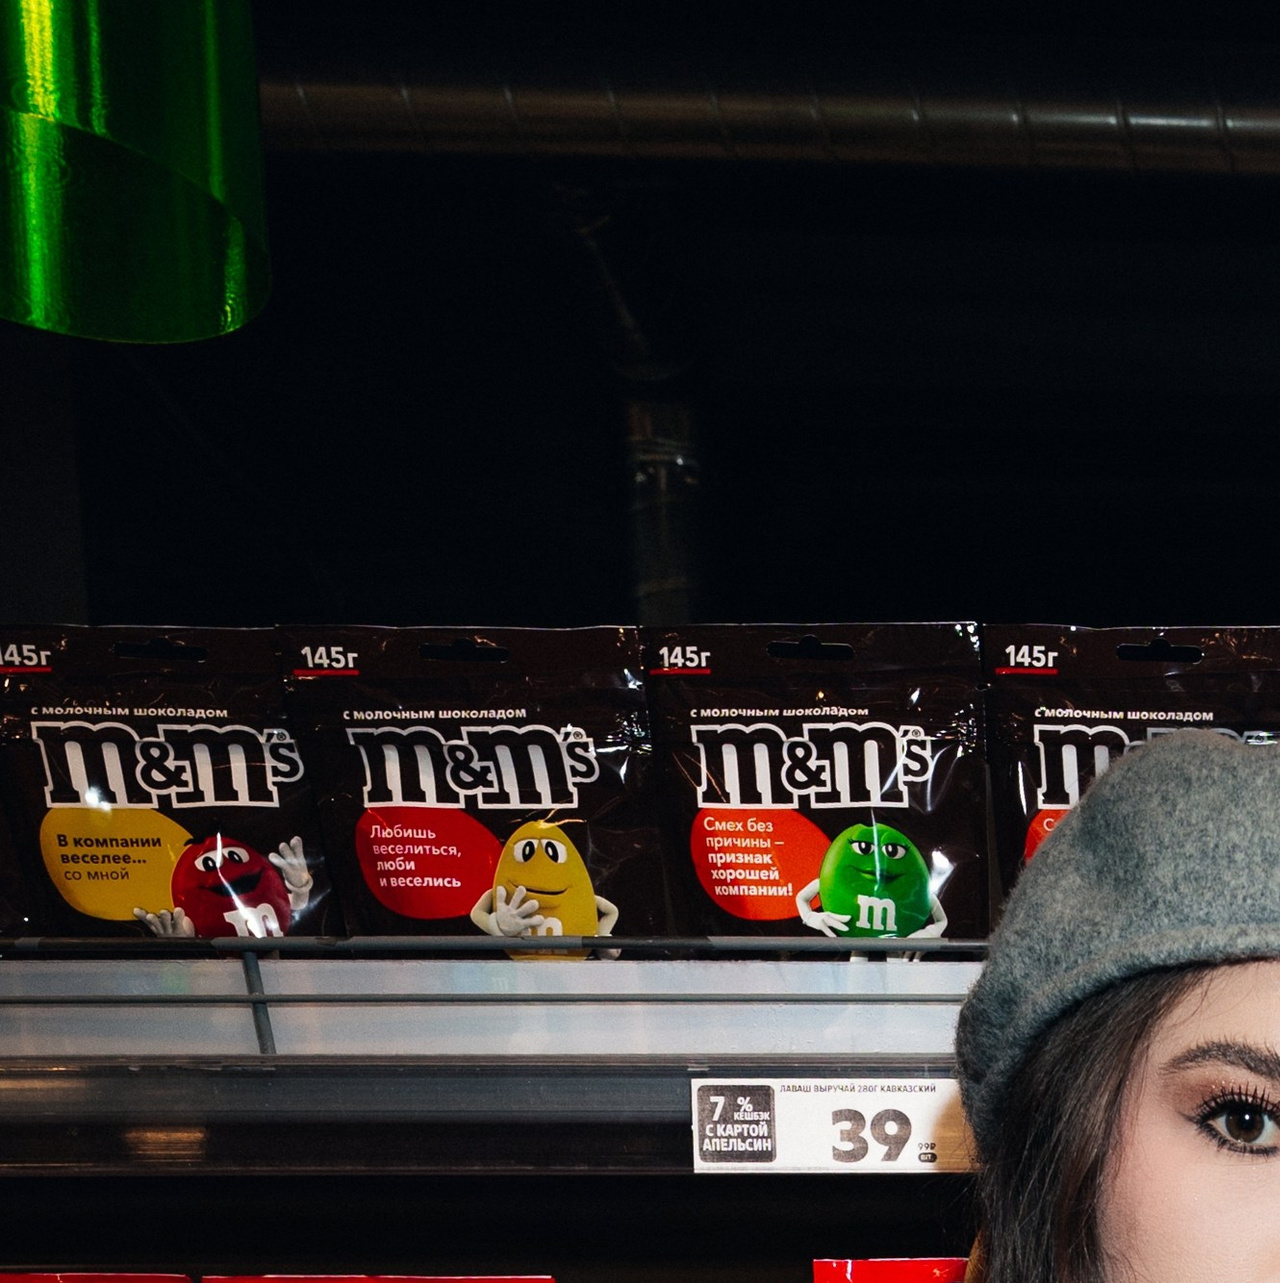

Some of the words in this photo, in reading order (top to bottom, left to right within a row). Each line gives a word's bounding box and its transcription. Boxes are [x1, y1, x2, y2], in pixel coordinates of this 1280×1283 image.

[301, 646, 358, 668] 145г
[659, 646, 710, 667] 145г
[1005, 645, 1058, 667] 145г
[42, 705, 130, 717] молочным
[133, 706, 228, 719] шоколадом
[353, 709, 435, 720] молочным
[438, 708, 527, 721] шоколадом
[700, 708, 780, 718] молочным
[783, 706, 869, 718] шоколадом
[1045, 708, 1124, 720] молочным
[1127, 710, 1214, 722] шоколадом
[703, 817, 744, 832] Смех
[747, 817, 774, 832] без
[370, 825, 436, 839] Любишь
[57, 834, 69, 848] В
[73, 836, 163, 849] компании
[705, 836, 772, 850] причины
[373, 844, 462, 858] веселиться,
[61, 853, 147, 865] веселее...
[377, 859, 415, 871] люби
[708, 852, 773, 867] признак
[64, 870, 83, 882] со
[87, 866, 130, 882] мной
[711, 867, 780, 883] хорошей
[390, 875, 462, 888] веселись
[715, 883, 793, 897] компании!
[856, 894, 898, 932] m
[780, 1084, 811, 1093] ЛАВАШ
[814, 1083, 855, 1093] ВЫРУЧАЙ
[880, 1083, 937, 1094] КАВКАЗСКИЙ
[709, 1096, 725, 1121] 7
[734, 1111, 771, 1121] КЕШБЭК
[716, 1123, 768, 1137] КАРТОЙ
[831, 1108, 912, 1163] 39
[703, 1138, 772, 1152] АПЕЛЬСИН
